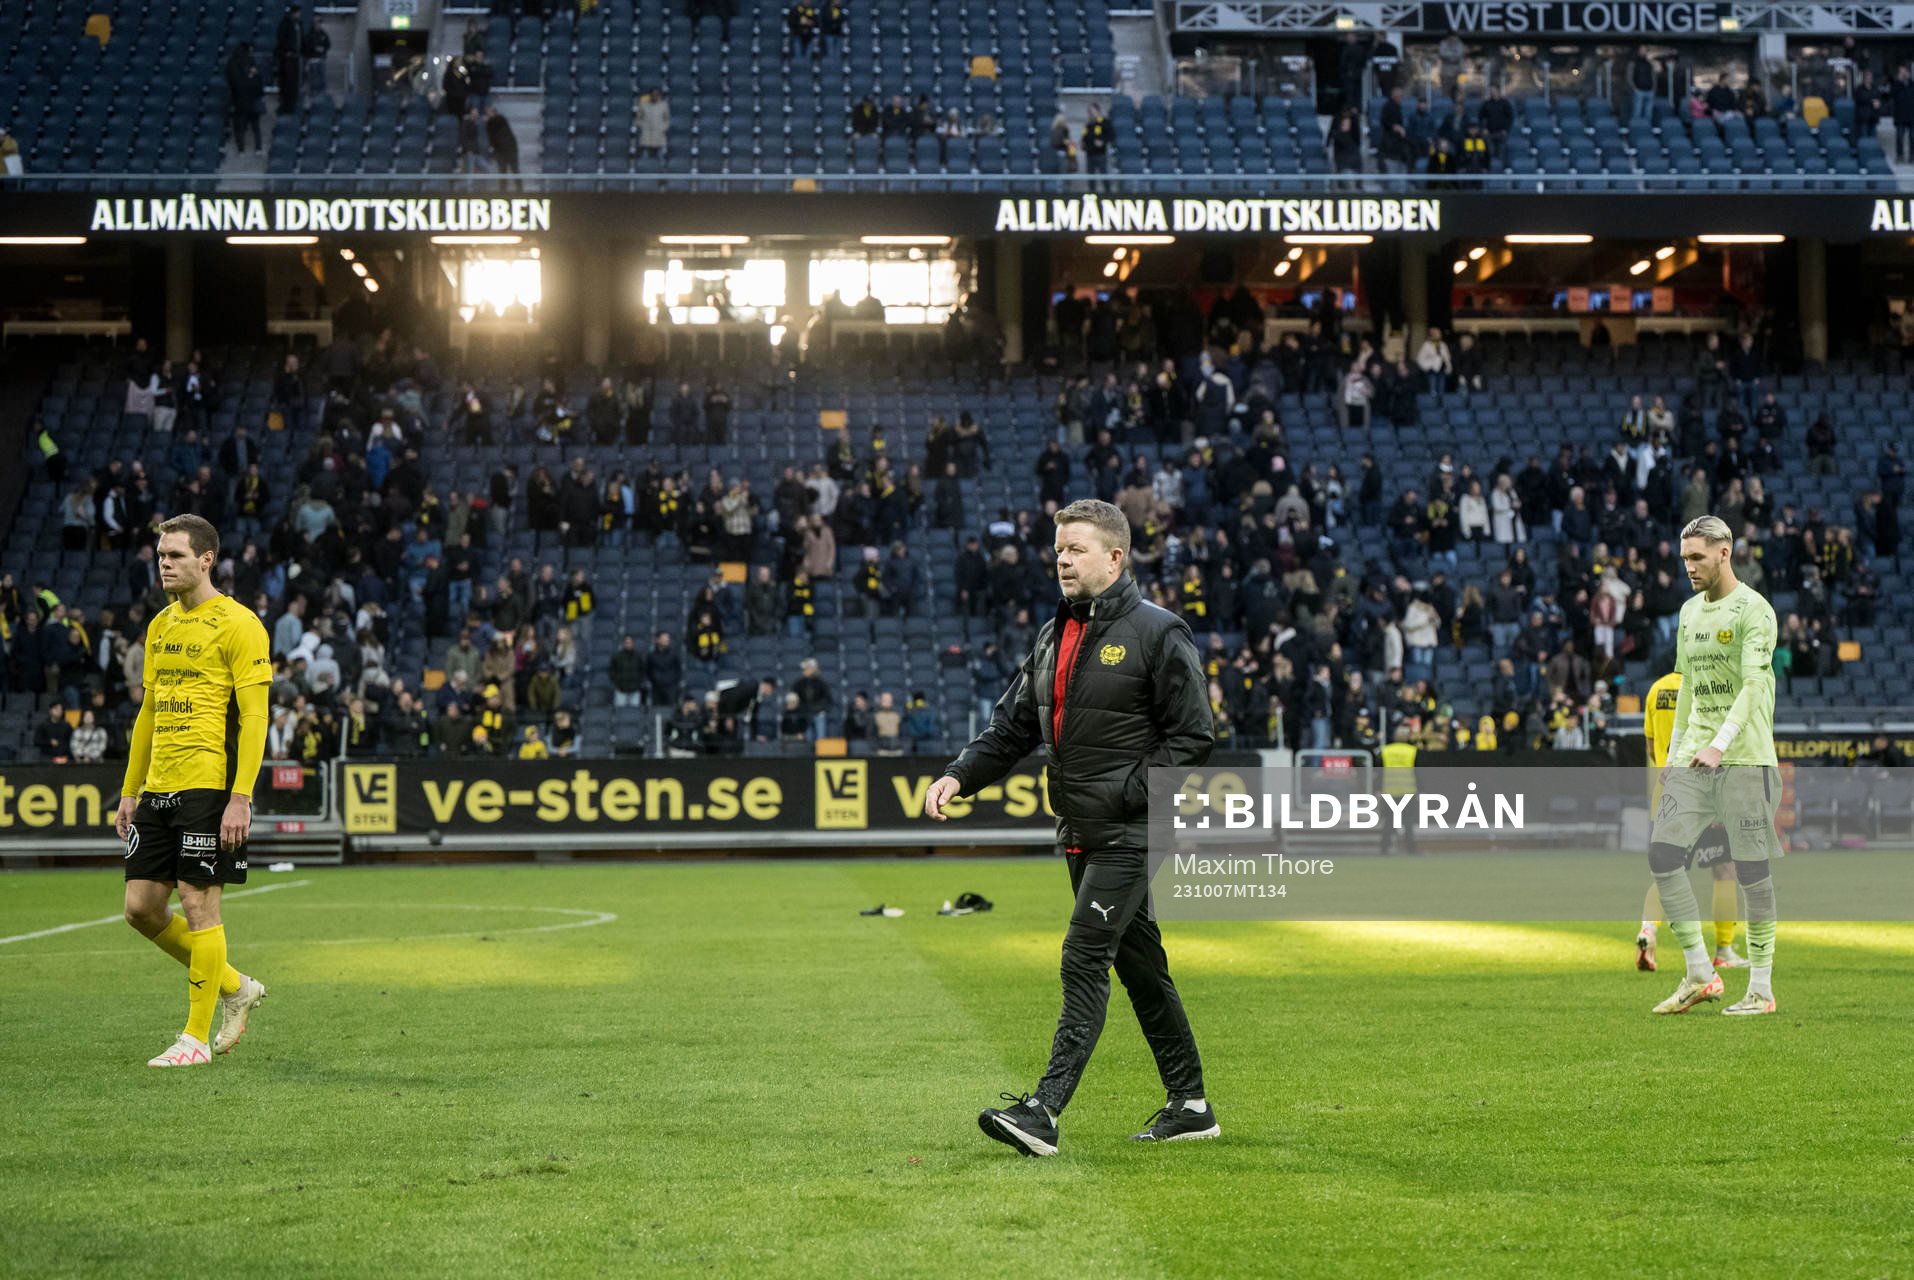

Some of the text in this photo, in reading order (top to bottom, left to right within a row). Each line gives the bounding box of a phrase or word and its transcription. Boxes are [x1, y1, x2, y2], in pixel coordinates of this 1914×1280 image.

[1446, 2, 1719, 32] WEST LOUNGE
[91, 193, 551, 231] ALLMÄNNA IDROTTSKLUBBEN
[996, 193, 1440, 231] ALLMÄNNA IDROTTSKLUBBEN
[1870, 199, 1914, 231] AL
[1711, 680, 1733, 696] Rock
[170, 696, 193, 714] Rock
[353, 772, 388, 804] VE
[422, 769, 783, 823] ve-sten.se
[824, 769, 859, 800] VE
[354, 813, 388, 823] STEN
[824, 809, 859, 820] STEN
[182, 835, 217, 847] LB-HUS
